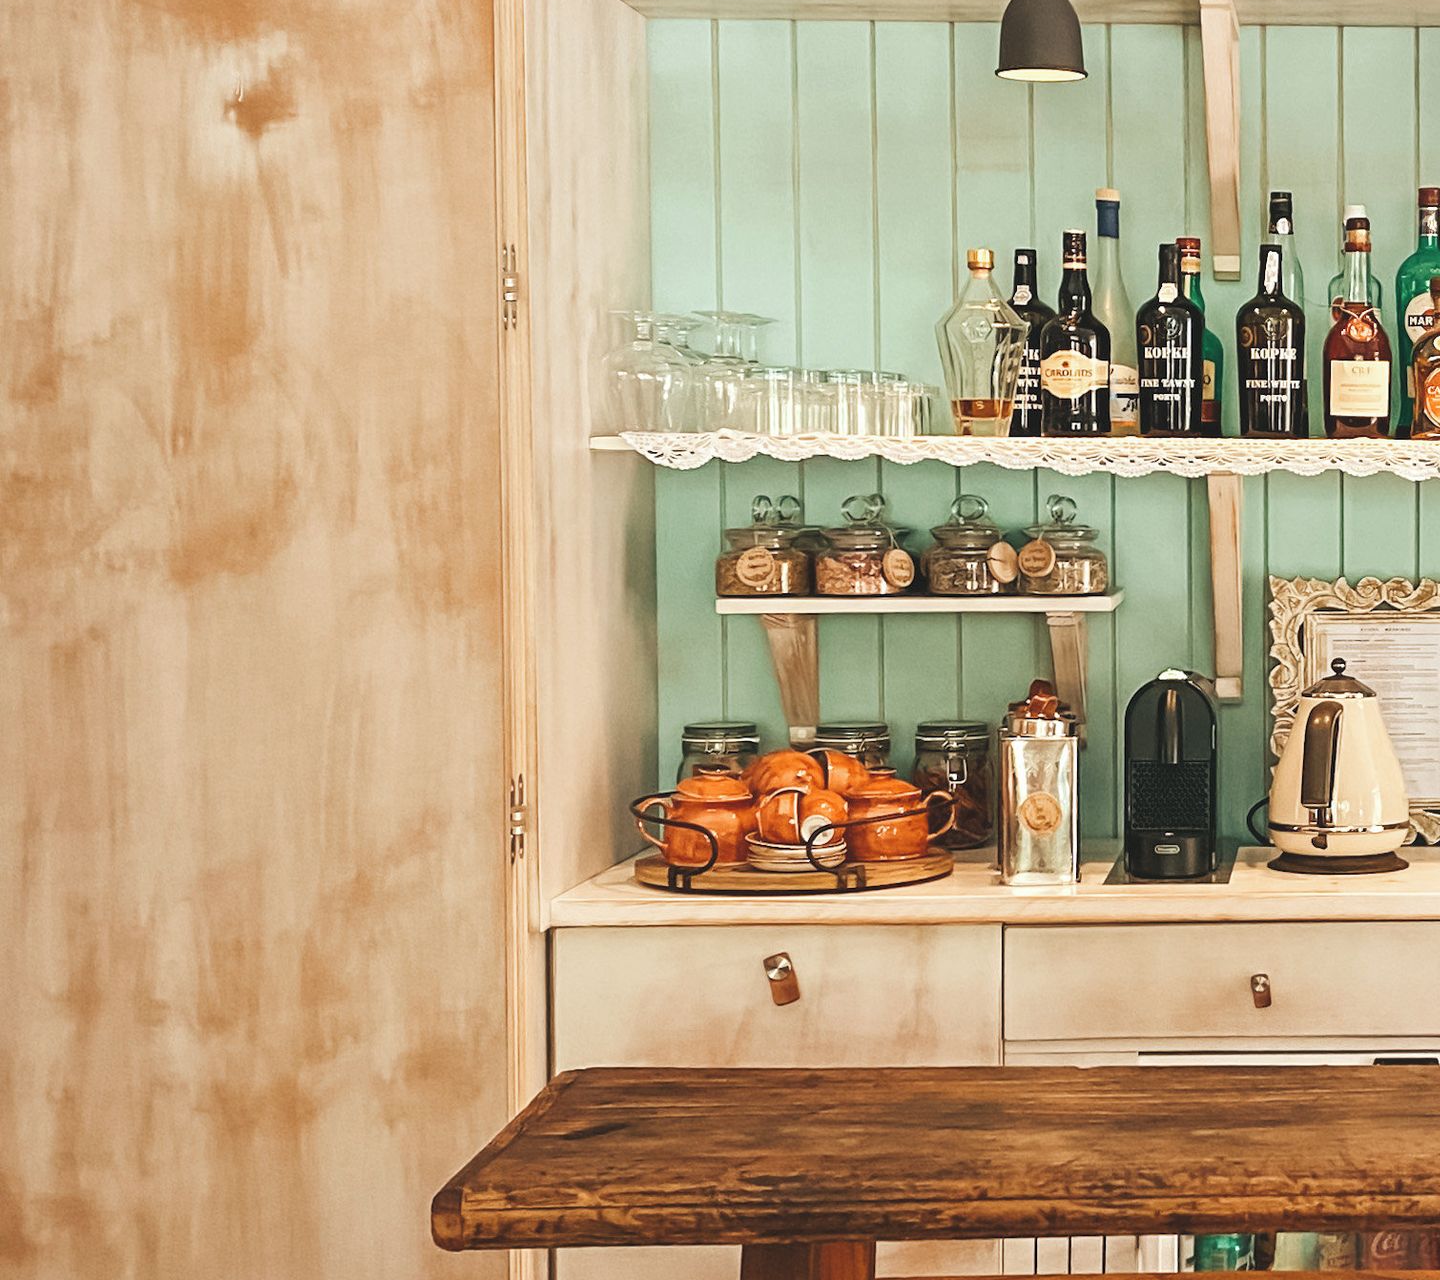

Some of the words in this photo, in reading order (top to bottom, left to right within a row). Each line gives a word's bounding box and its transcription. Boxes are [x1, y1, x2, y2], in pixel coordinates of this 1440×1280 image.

[1409, 316, 1434, 327] MAR
[1250, 347, 1297, 360] KOPKE
[1246, 379, 1268, 389] FINE
[1153, 393, 1181, 402] PORTO
[1259, 393, 1288, 403] PORTO
